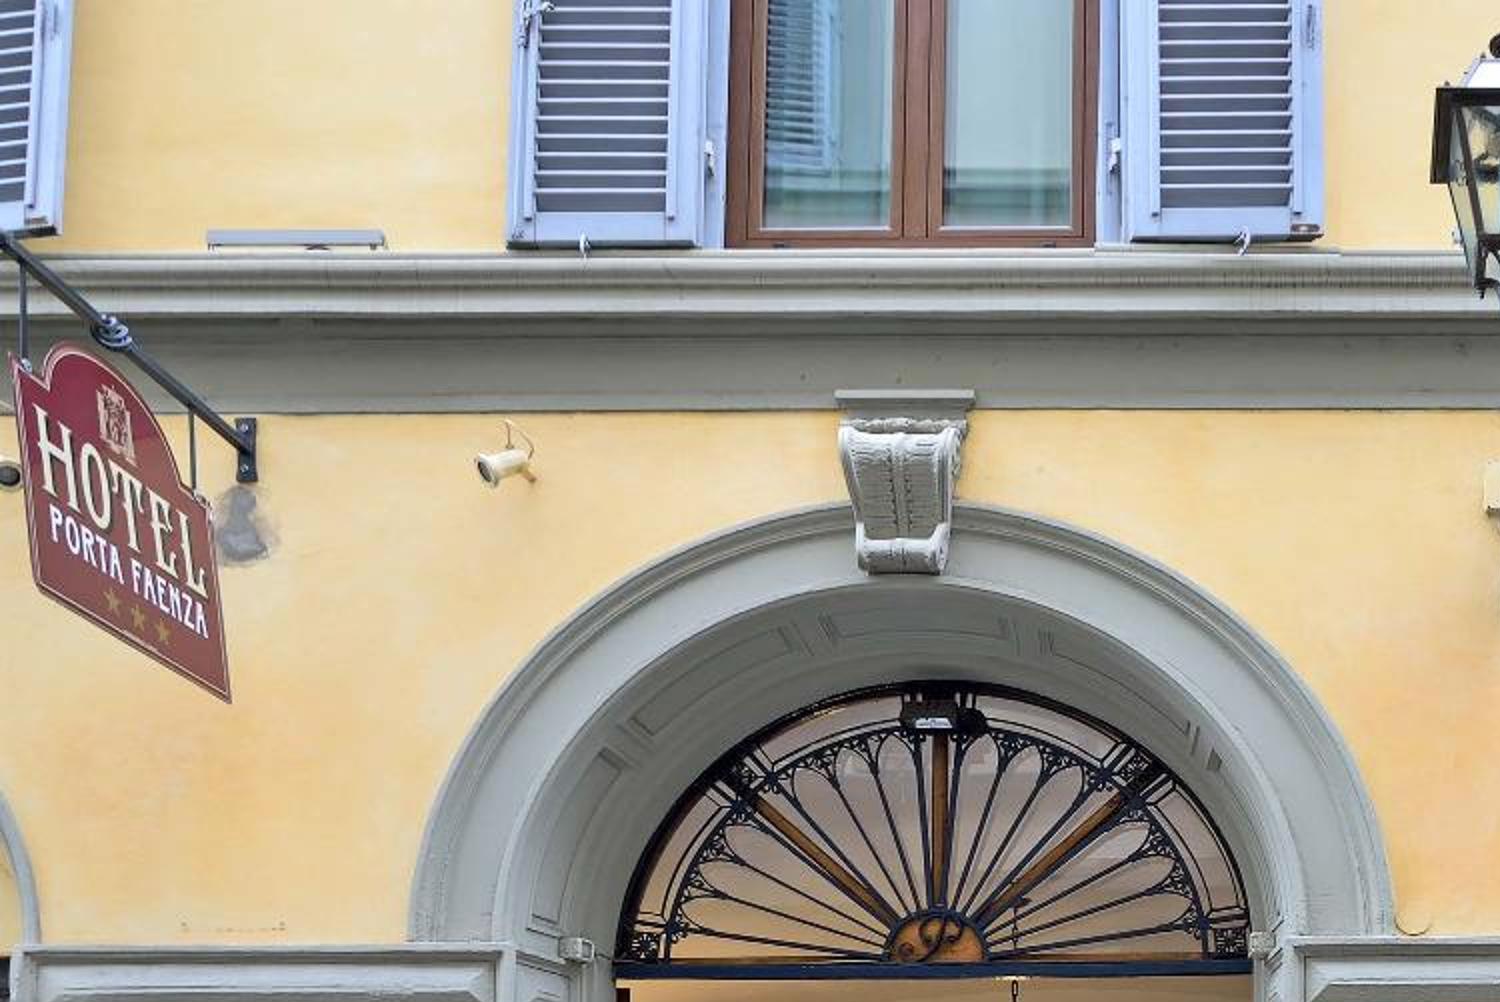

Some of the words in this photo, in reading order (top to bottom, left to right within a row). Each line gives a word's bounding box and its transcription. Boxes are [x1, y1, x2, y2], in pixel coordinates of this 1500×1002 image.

[32, 403, 209, 599] HOTEL
[49, 503, 125, 585] PORTA
[131, 557, 209, 639] FAENZA
